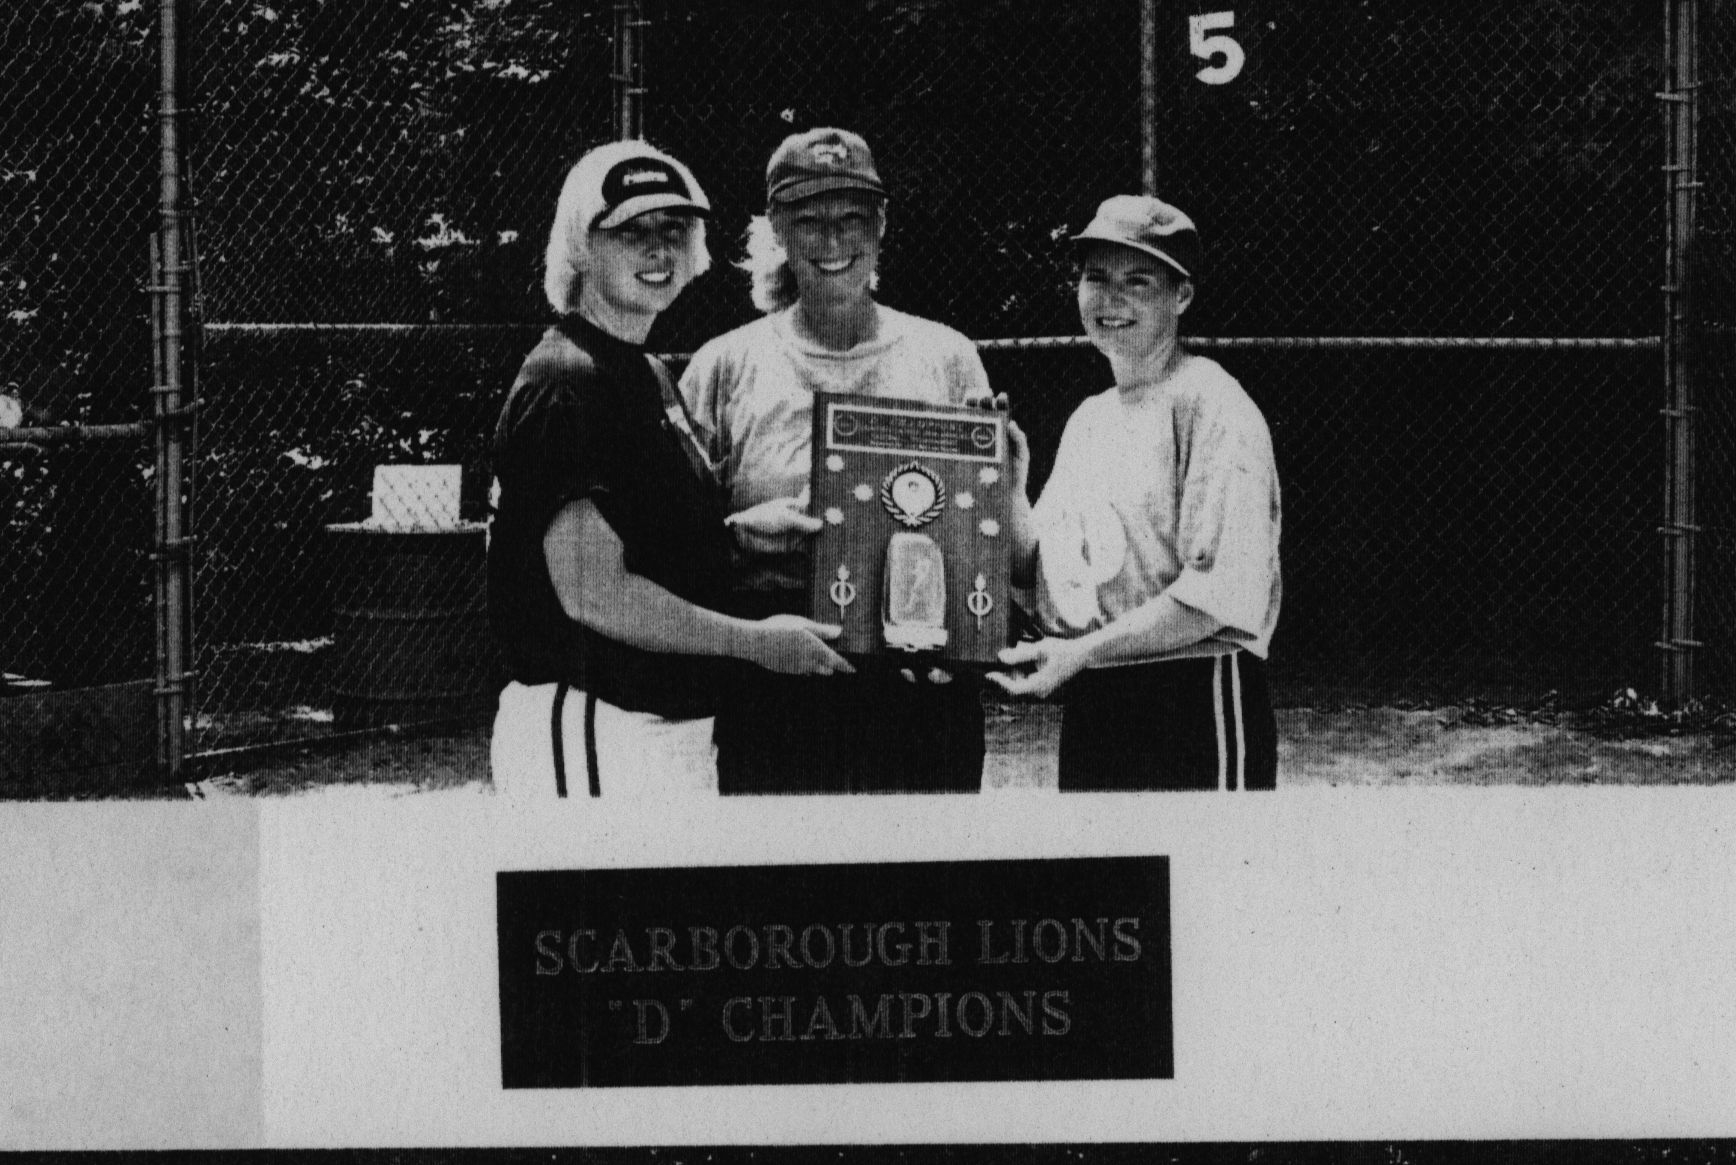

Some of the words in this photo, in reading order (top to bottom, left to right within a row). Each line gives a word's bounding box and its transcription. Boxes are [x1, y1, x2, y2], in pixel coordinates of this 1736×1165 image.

[1189, 10, 1246, 85] 5
[534, 919, 952, 976] SCARBOROUGH
[976, 917, 1142, 964] LIONS
[608, 998, 693, 1044] "D"
[722, 990, 1072, 1042] CHAMPIONS
